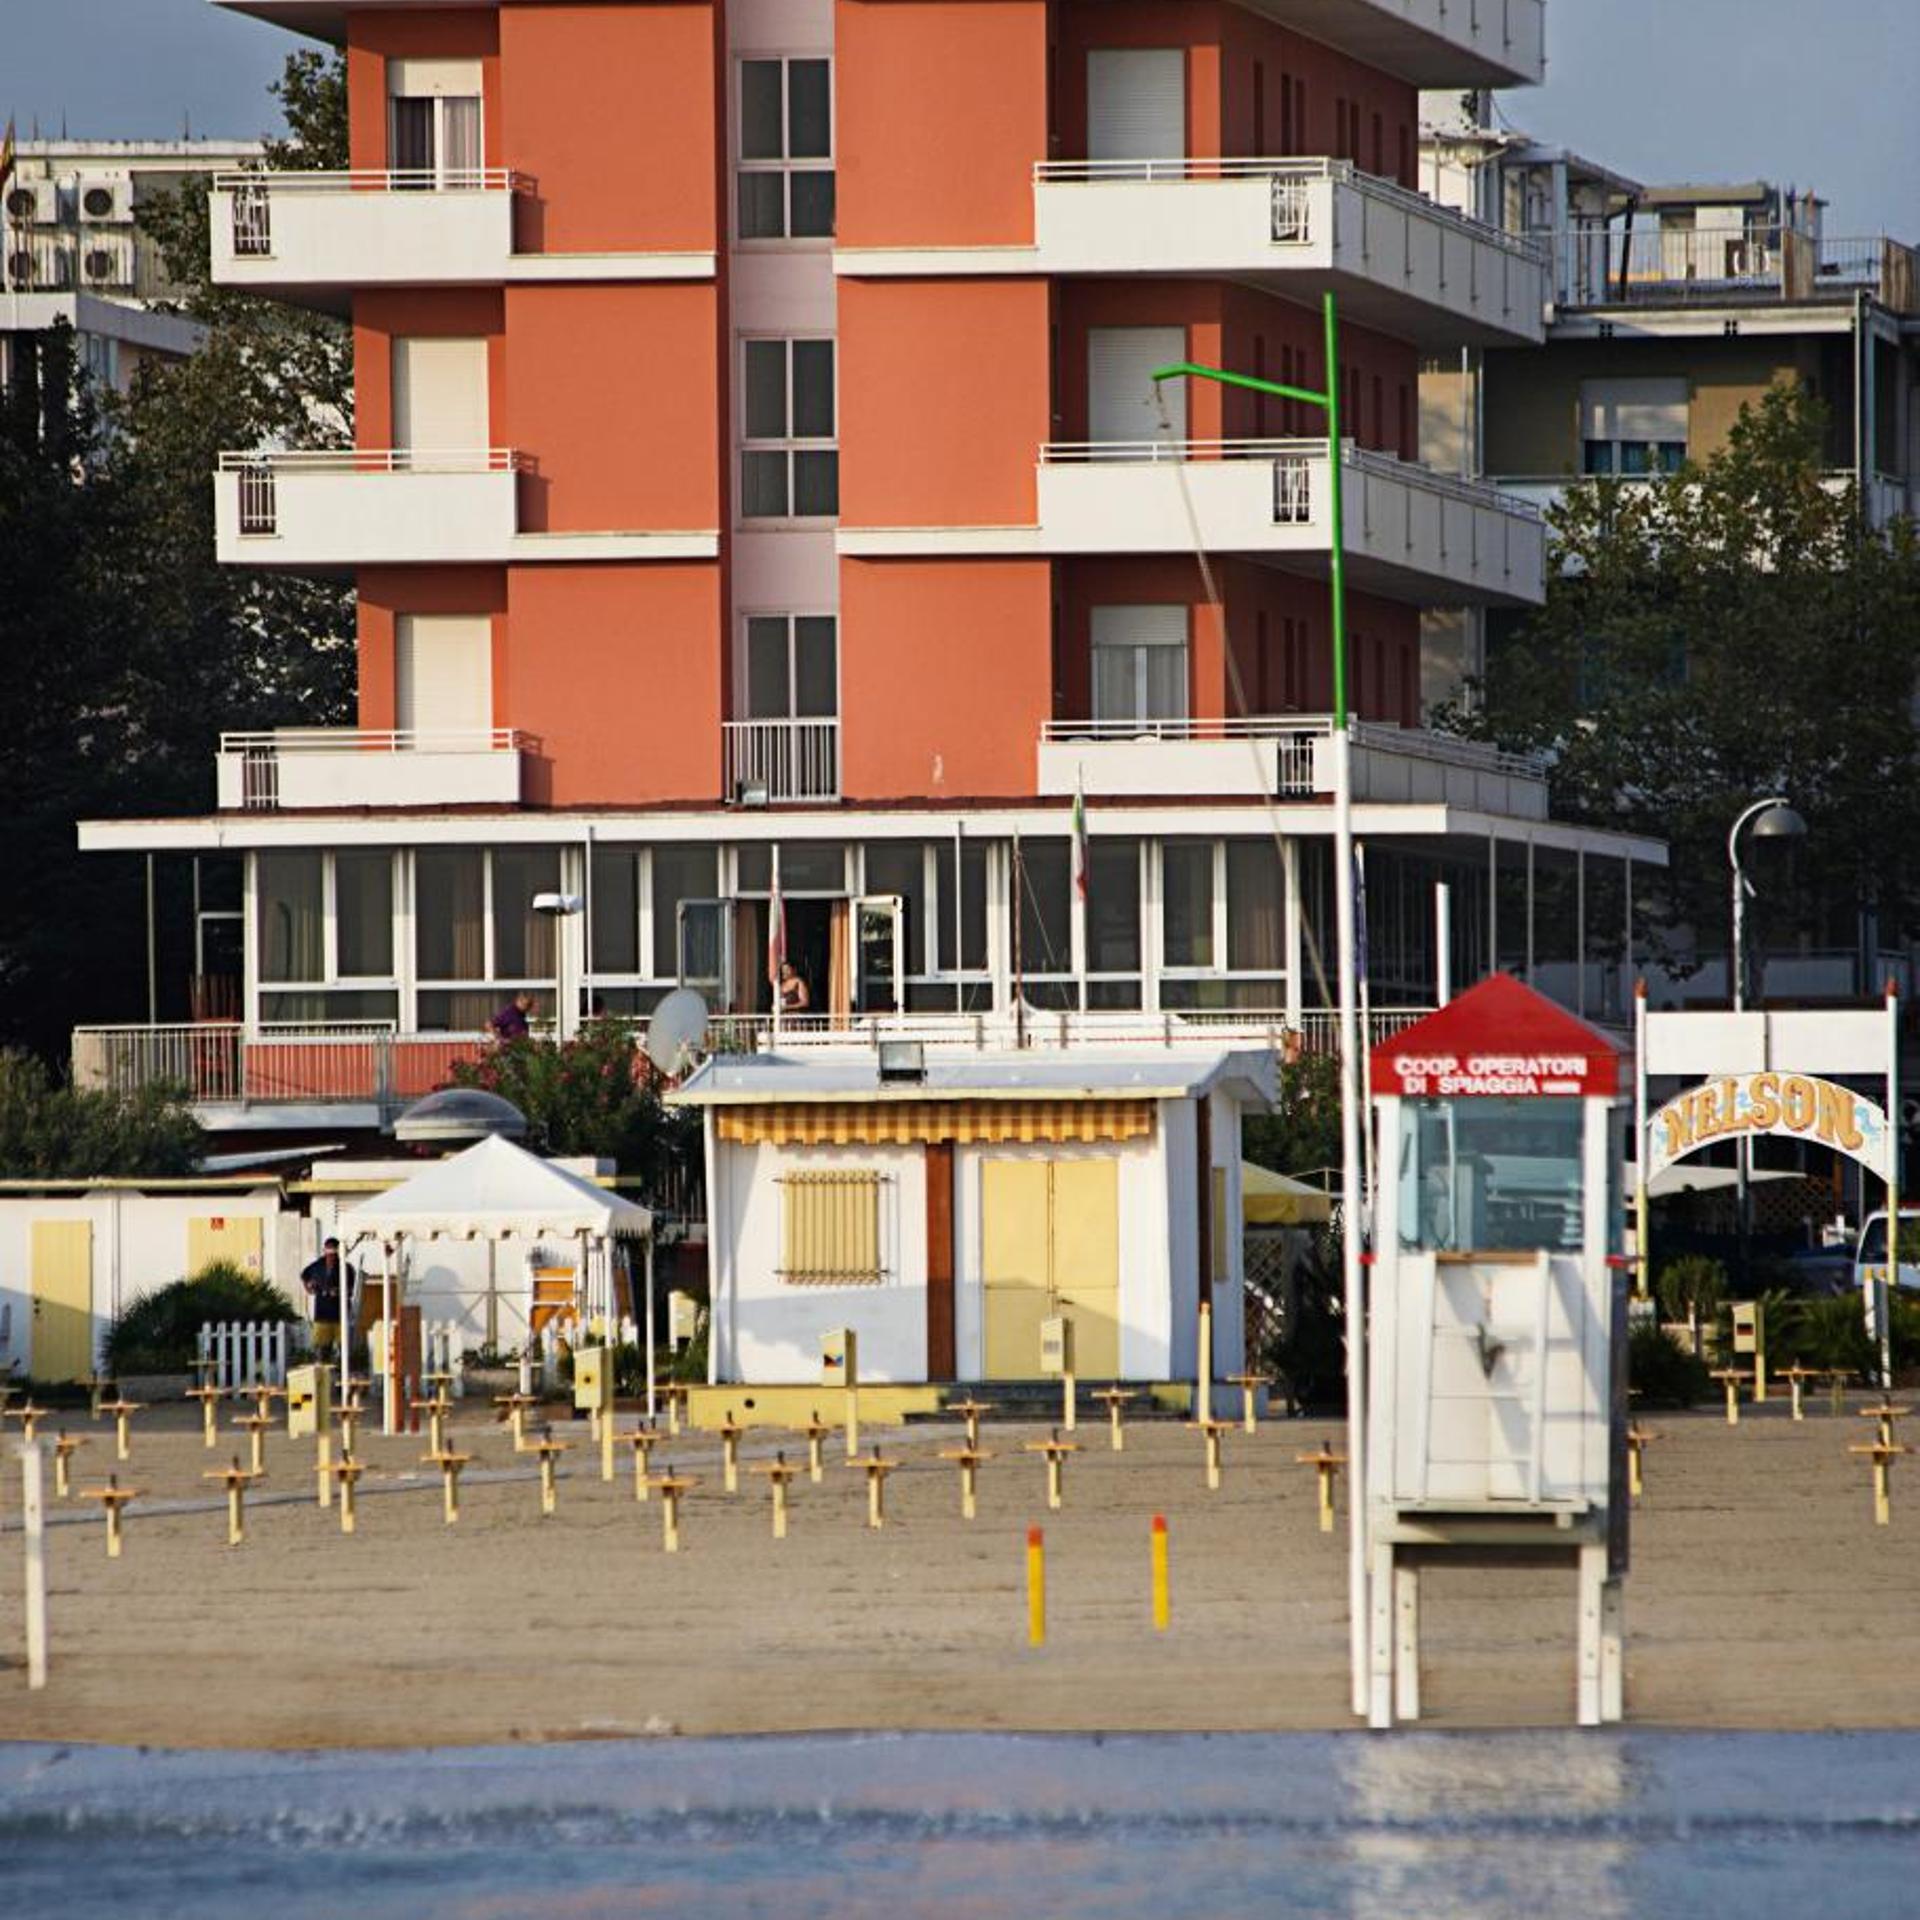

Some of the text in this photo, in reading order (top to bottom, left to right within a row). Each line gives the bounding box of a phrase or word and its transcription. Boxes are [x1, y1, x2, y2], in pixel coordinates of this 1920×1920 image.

[1395, 1057, 1587, 1076] COOP. OPERATORI
[1404, 1076, 1427, 1094] DI
[1438, 1076, 1538, 1094] SPIAGGIA
[1663, 1072, 1864, 1156] NELSON
